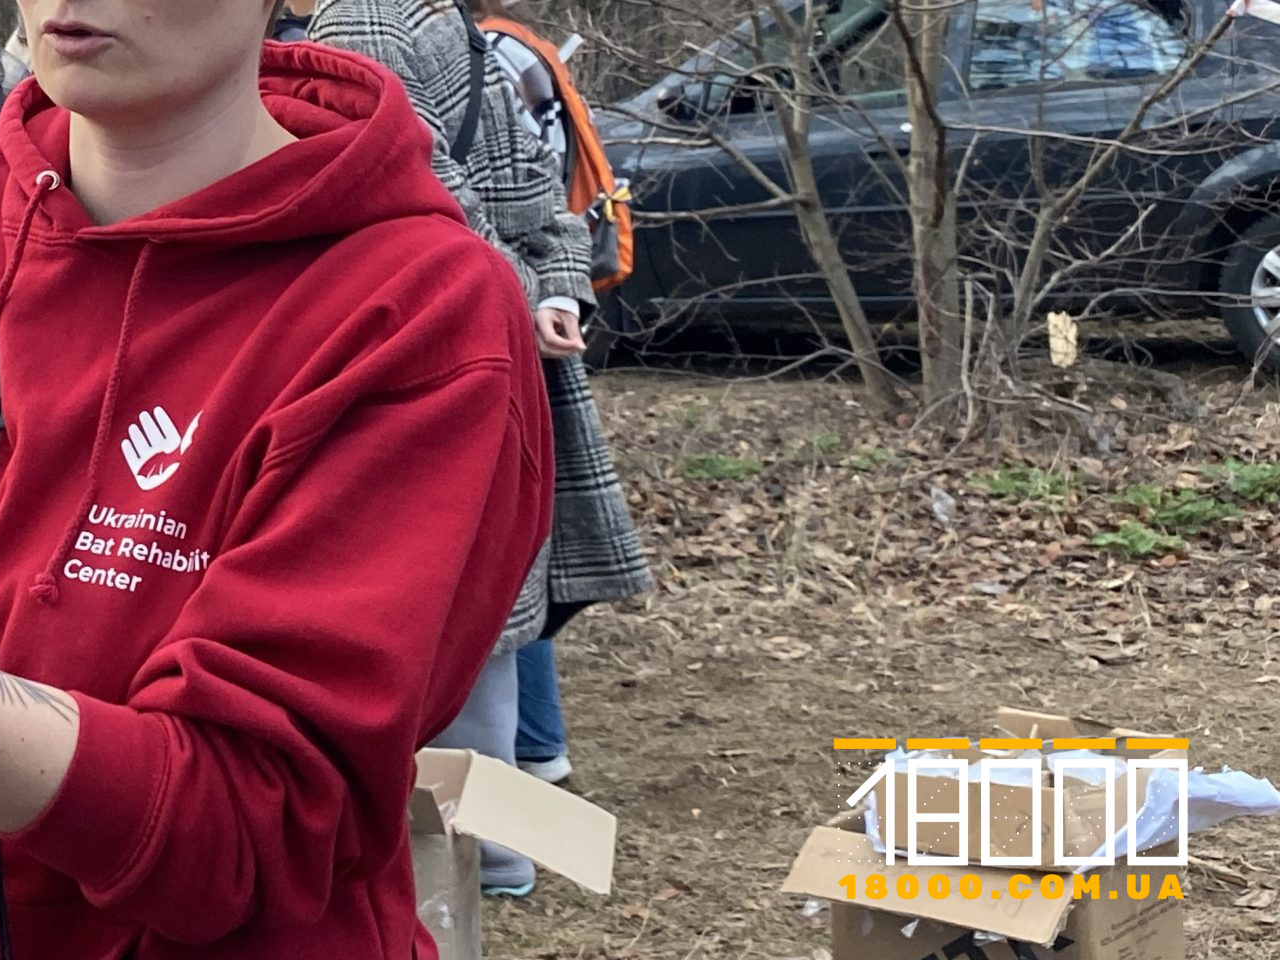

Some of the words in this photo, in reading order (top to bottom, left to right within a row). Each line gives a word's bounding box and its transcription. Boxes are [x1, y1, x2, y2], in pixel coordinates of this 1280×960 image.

[88, 504, 187, 540] Ukrainian
[74, 530, 115, 556] Bat
[63, 558, 142, 592] Center
